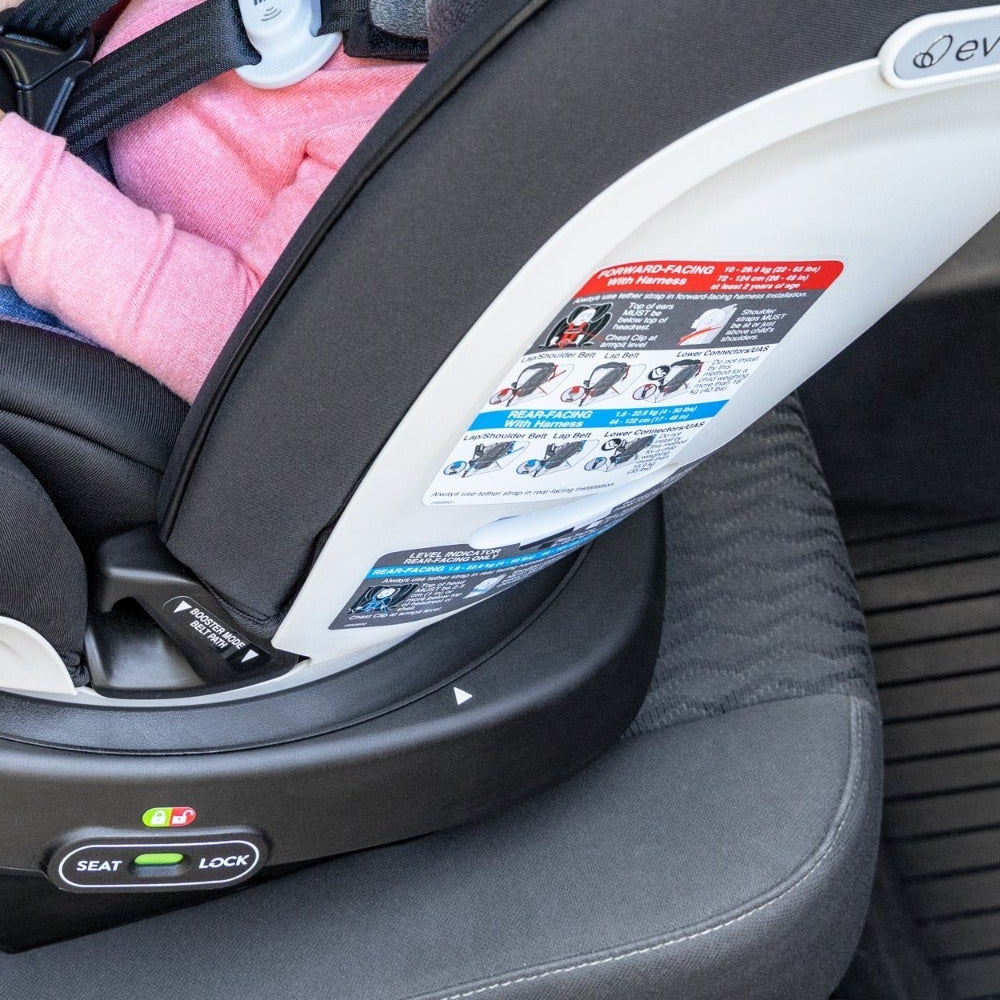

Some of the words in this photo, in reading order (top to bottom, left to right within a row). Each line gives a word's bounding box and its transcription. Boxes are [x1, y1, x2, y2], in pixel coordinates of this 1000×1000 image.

[597, 265, 715, 279] FORWARD-FACING
[760, 266, 772, 274] kg
[607, 276, 634, 287] With
[635, 275, 687, 286] Harness
[573, 294, 601, 304] Always
[618, 292, 643, 300] tether
[643, 292, 666, 301] strap
[675, 293, 733, 301] forward-facing
[628, 302, 645, 310] Top
[645, 302, 656, 310] of
[622, 309, 651, 317] MUST
[741, 308, 777, 316] Shoulder
[643, 317, 658, 325] top
[760, 313, 788, 321] MUST
[612, 323, 650, 331] headrest.
[759, 320, 776, 329] just
[725, 328, 750, 336] above
[630, 334, 648, 342] Clip
[599, 341, 627, 349] armpit
[577, 351, 597, 359] Belt
[604, 352, 621, 360] Lap
[622, 351, 640, 359] Belt
[676, 350, 703, 358] Lower
[507, 410, 593, 419] REAR-FACING
[504, 420, 532, 428] With
[533, 419, 585, 428] Harness
[528, 432, 548, 440] Belt
[552, 432, 571, 440] Lap
[533, 487, 574, 495] rear-facing
[409, 551, 442, 559] LEVEL
[444, 548, 502, 558] INDICATOR
[403, 556, 471, 565] REAR-FACING
[372, 566, 445, 575] REAR-FACING
[189, 607, 226, 635] BOOSTER
[221, 630, 246, 650] MODE
[189, 620, 211, 636] BELT
[206, 632, 229, 649] PATH
[76, 860, 122, 872] SEAT
[199, 854, 251, 869] LOCK
